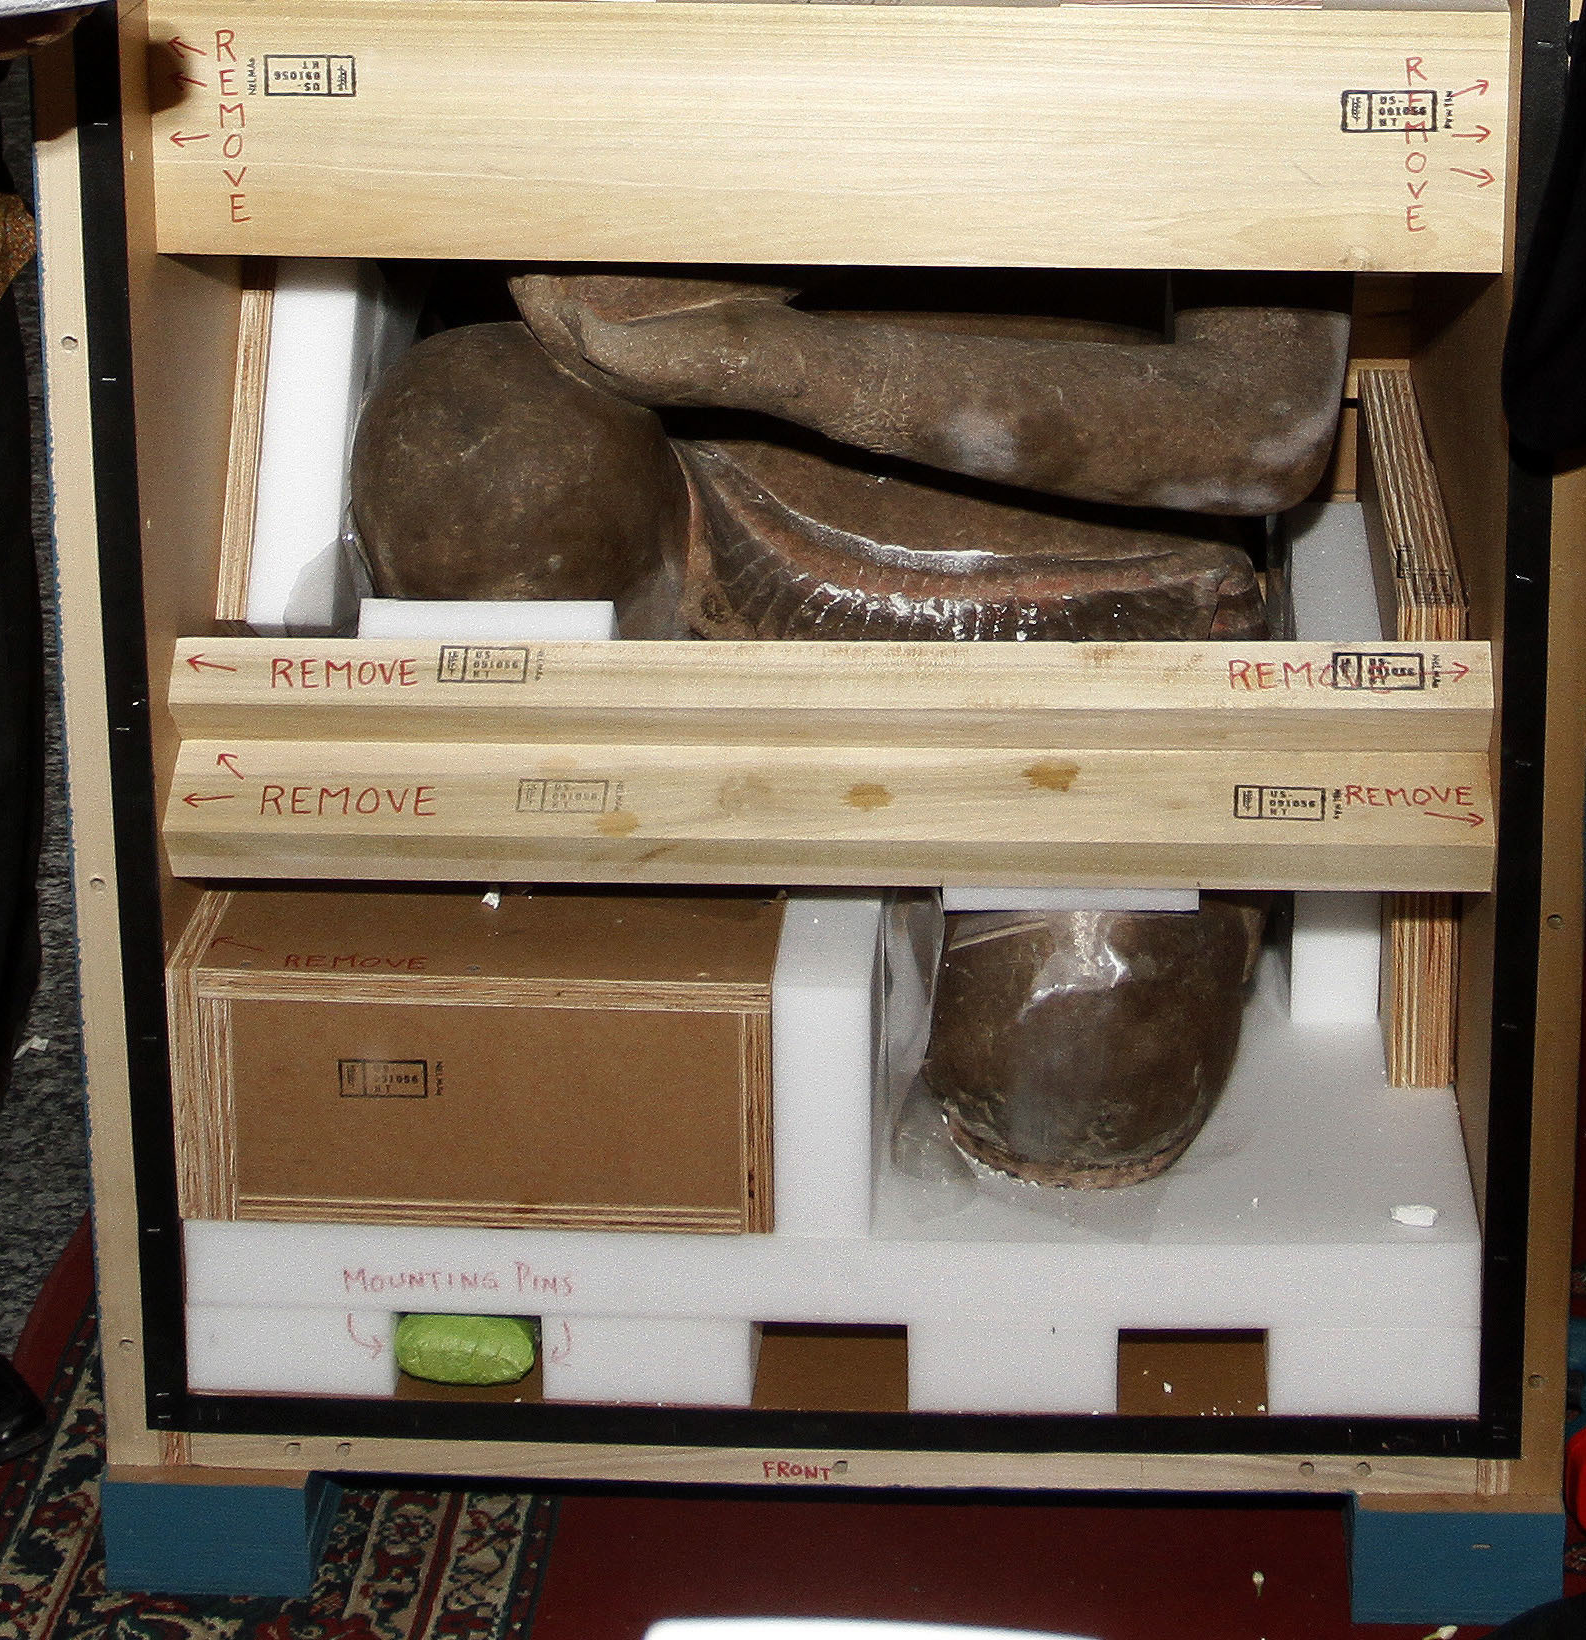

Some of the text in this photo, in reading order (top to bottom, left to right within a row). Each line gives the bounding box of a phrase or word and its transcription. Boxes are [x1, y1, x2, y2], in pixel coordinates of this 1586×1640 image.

[215, 29, 252, 224] REMOVE
[1405, 56, 1429, 233] REMOVE
[271, 657, 419, 689] REMOVE
[1228, 658, 1393, 694] REMOVE
[260, 784, 436, 817] REMOVE
[1346, 784, 1473, 807] REMOVE
[283, 953, 429, 971] REMOVE
[342, 1265, 500, 1294] MOUNTING
[763, 1461, 832, 1481] FRONT
